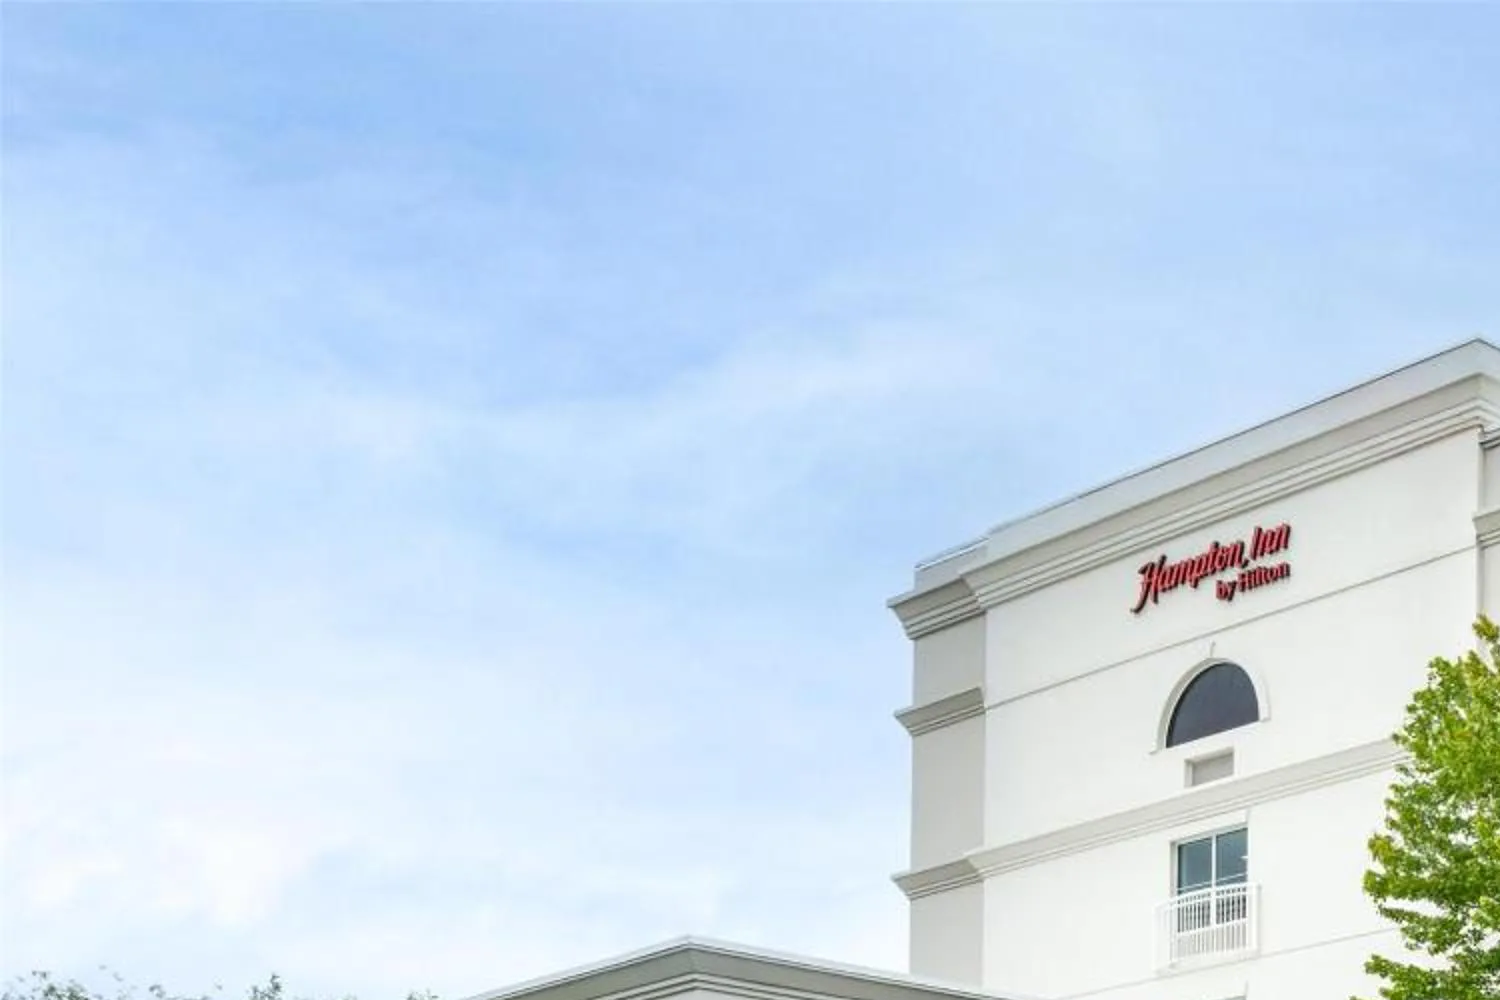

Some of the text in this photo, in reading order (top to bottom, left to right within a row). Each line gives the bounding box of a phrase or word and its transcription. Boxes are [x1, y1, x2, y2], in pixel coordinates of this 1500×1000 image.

[1131, 524, 1291, 613] Hampton Inn
[1216, 563, 1291, 602] by Hilton
